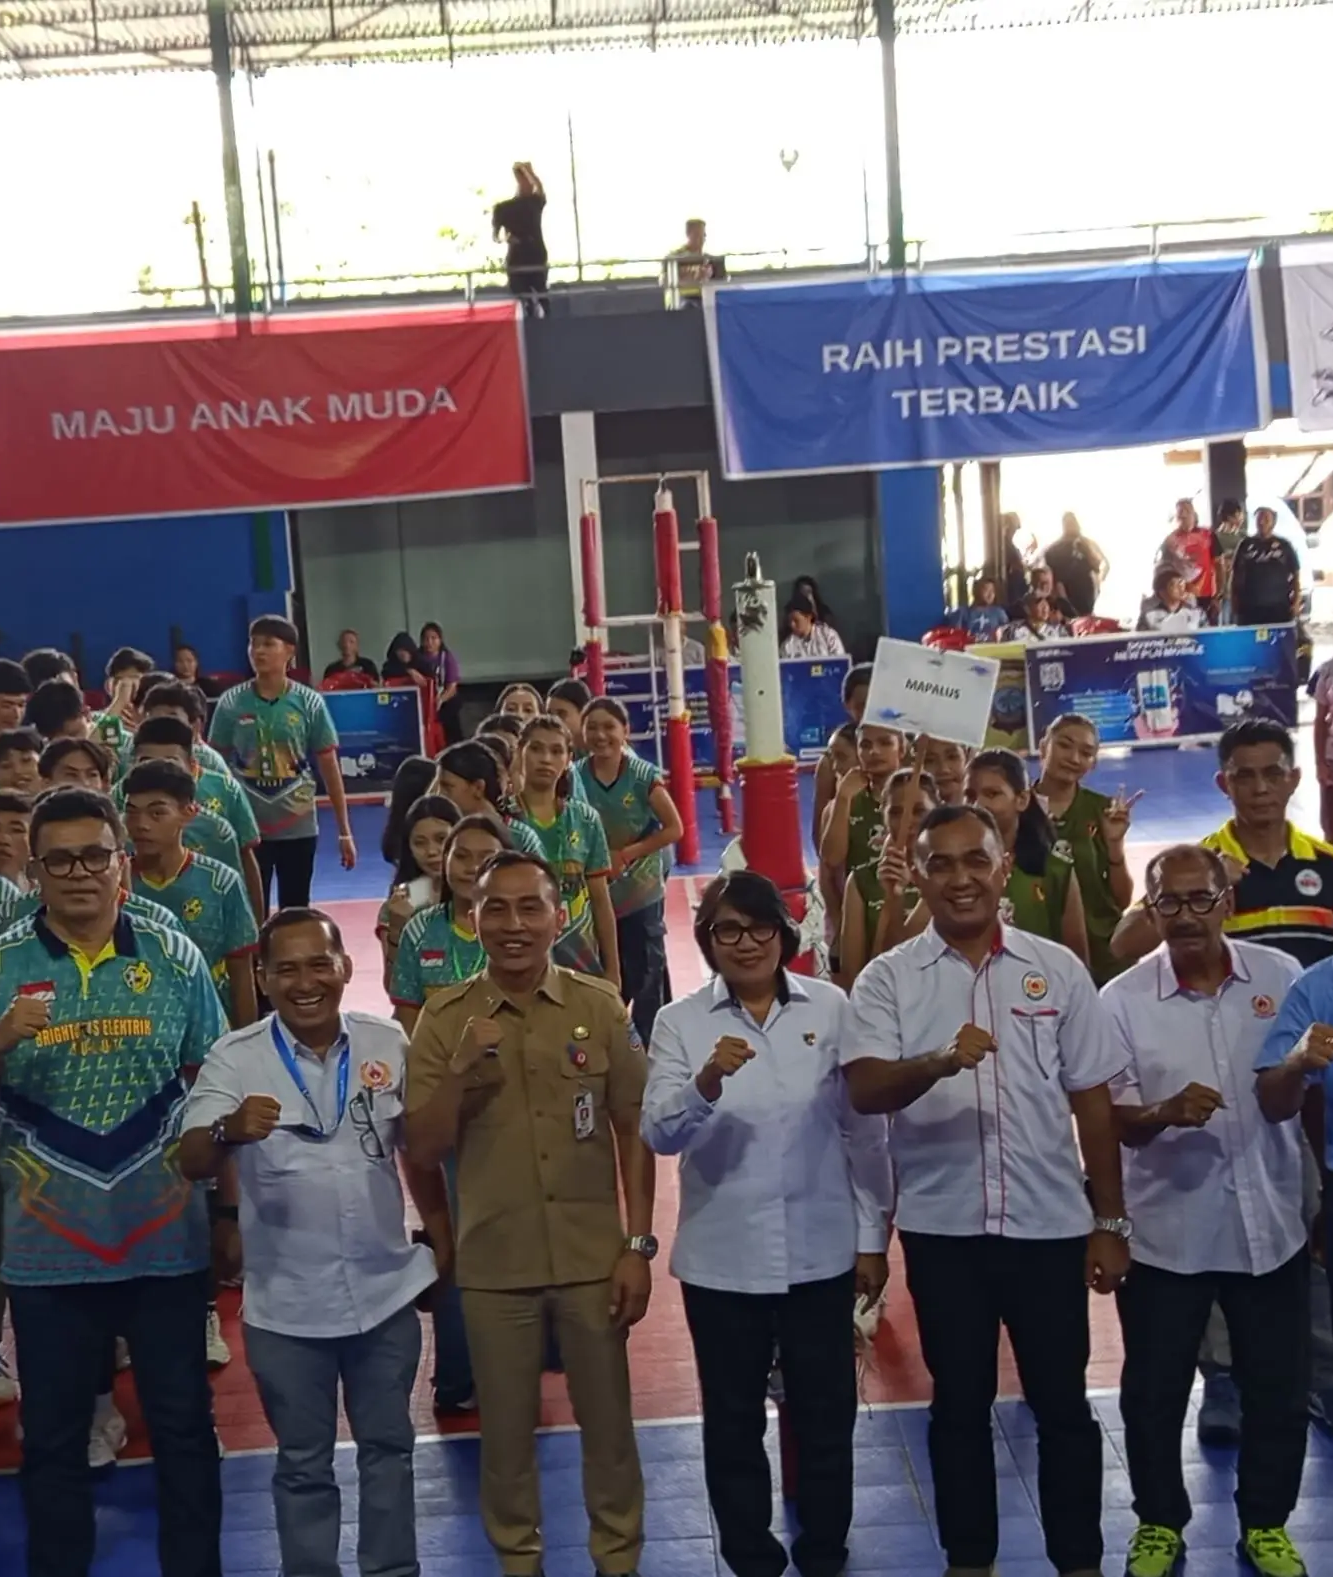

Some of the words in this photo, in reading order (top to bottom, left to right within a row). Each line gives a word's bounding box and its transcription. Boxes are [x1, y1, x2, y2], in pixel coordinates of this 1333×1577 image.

[822, 339, 922, 373] RAIH
[937, 325, 1146, 366] PRESTASI
[50, 405, 175, 440] MAJU
[190, 396, 315, 431] ANAK
[328, 385, 458, 423] MUDA
[891, 379, 1079, 420] TERBAIK
[904, 678, 962, 700] MAPALUS
